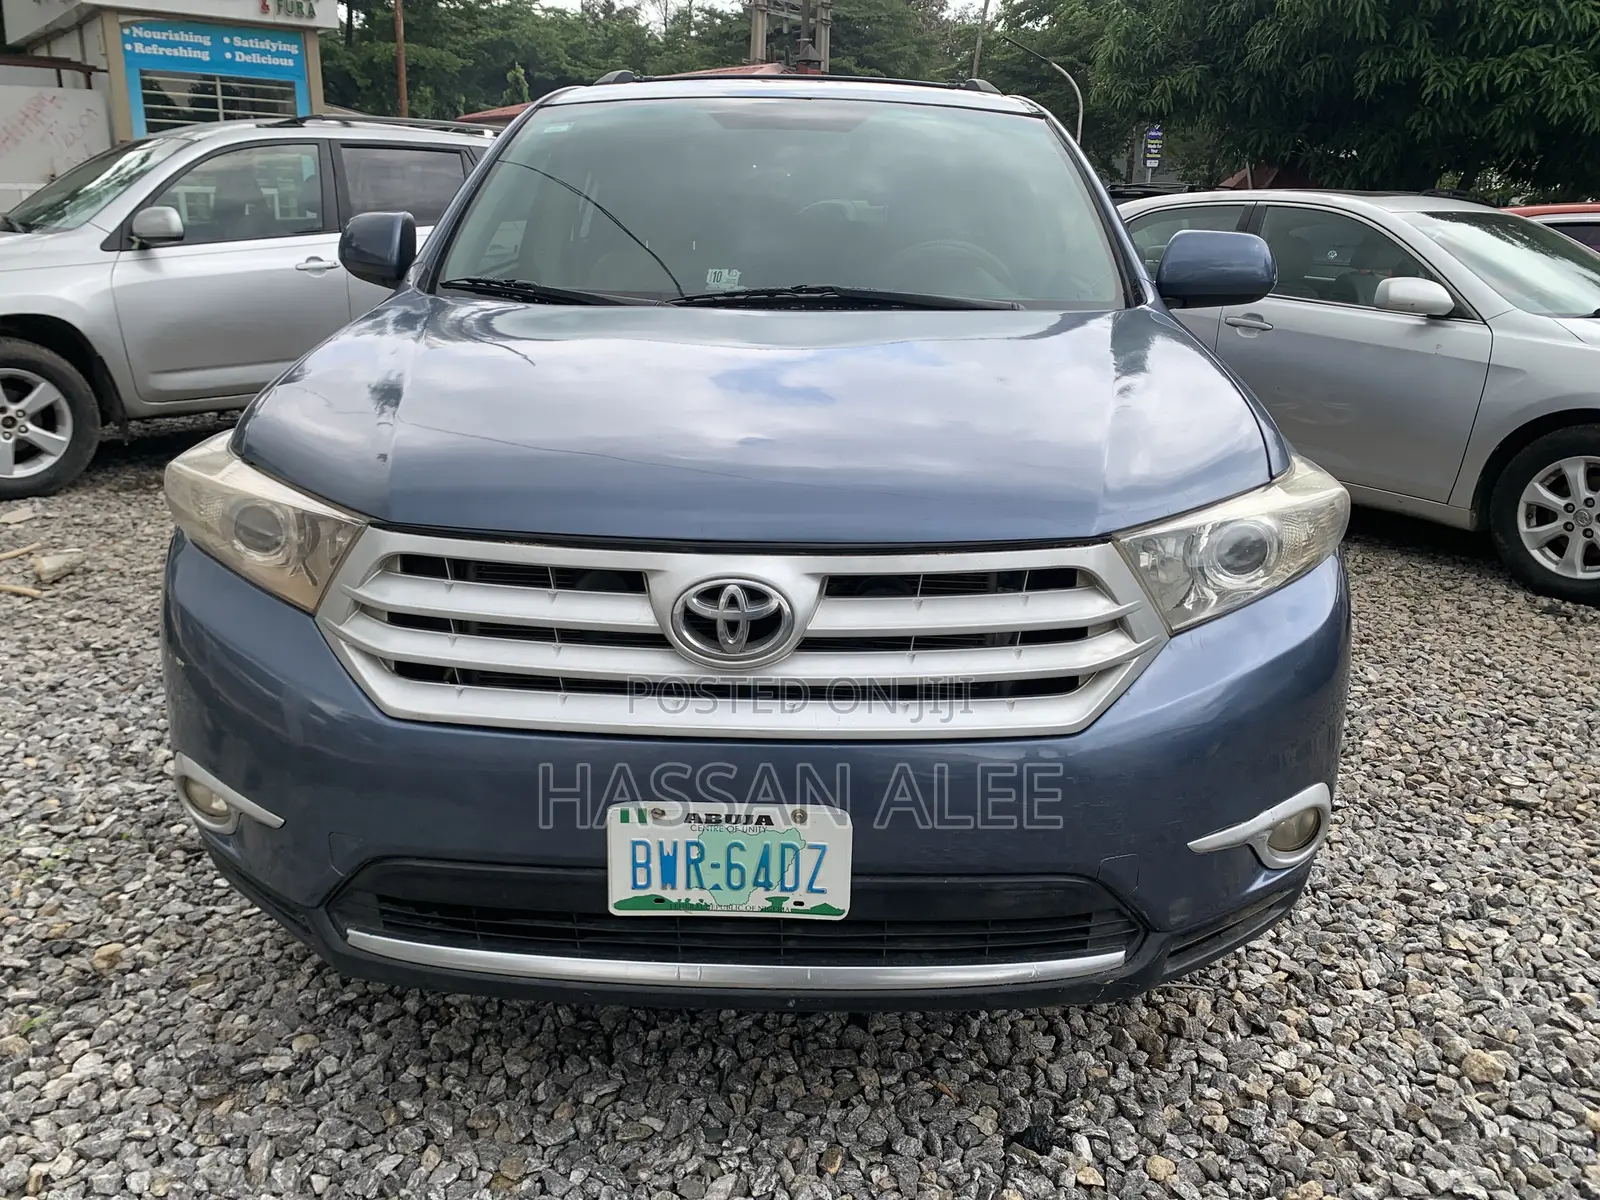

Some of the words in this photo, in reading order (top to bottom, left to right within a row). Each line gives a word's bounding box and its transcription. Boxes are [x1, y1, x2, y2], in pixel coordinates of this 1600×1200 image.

[132, 26, 211, 46] Nourishing
[233, 36, 299, 54] Satisfying
[134, 42, 210, 61] Refreshing
[235, 51, 294, 67] Delicious
[684, 813, 774, 826] ABUJA
[690, 824, 724, 832] CENTRE
[727, 825, 741, 833] OF
[631, 839, 828, 894] BWR-64DZ
